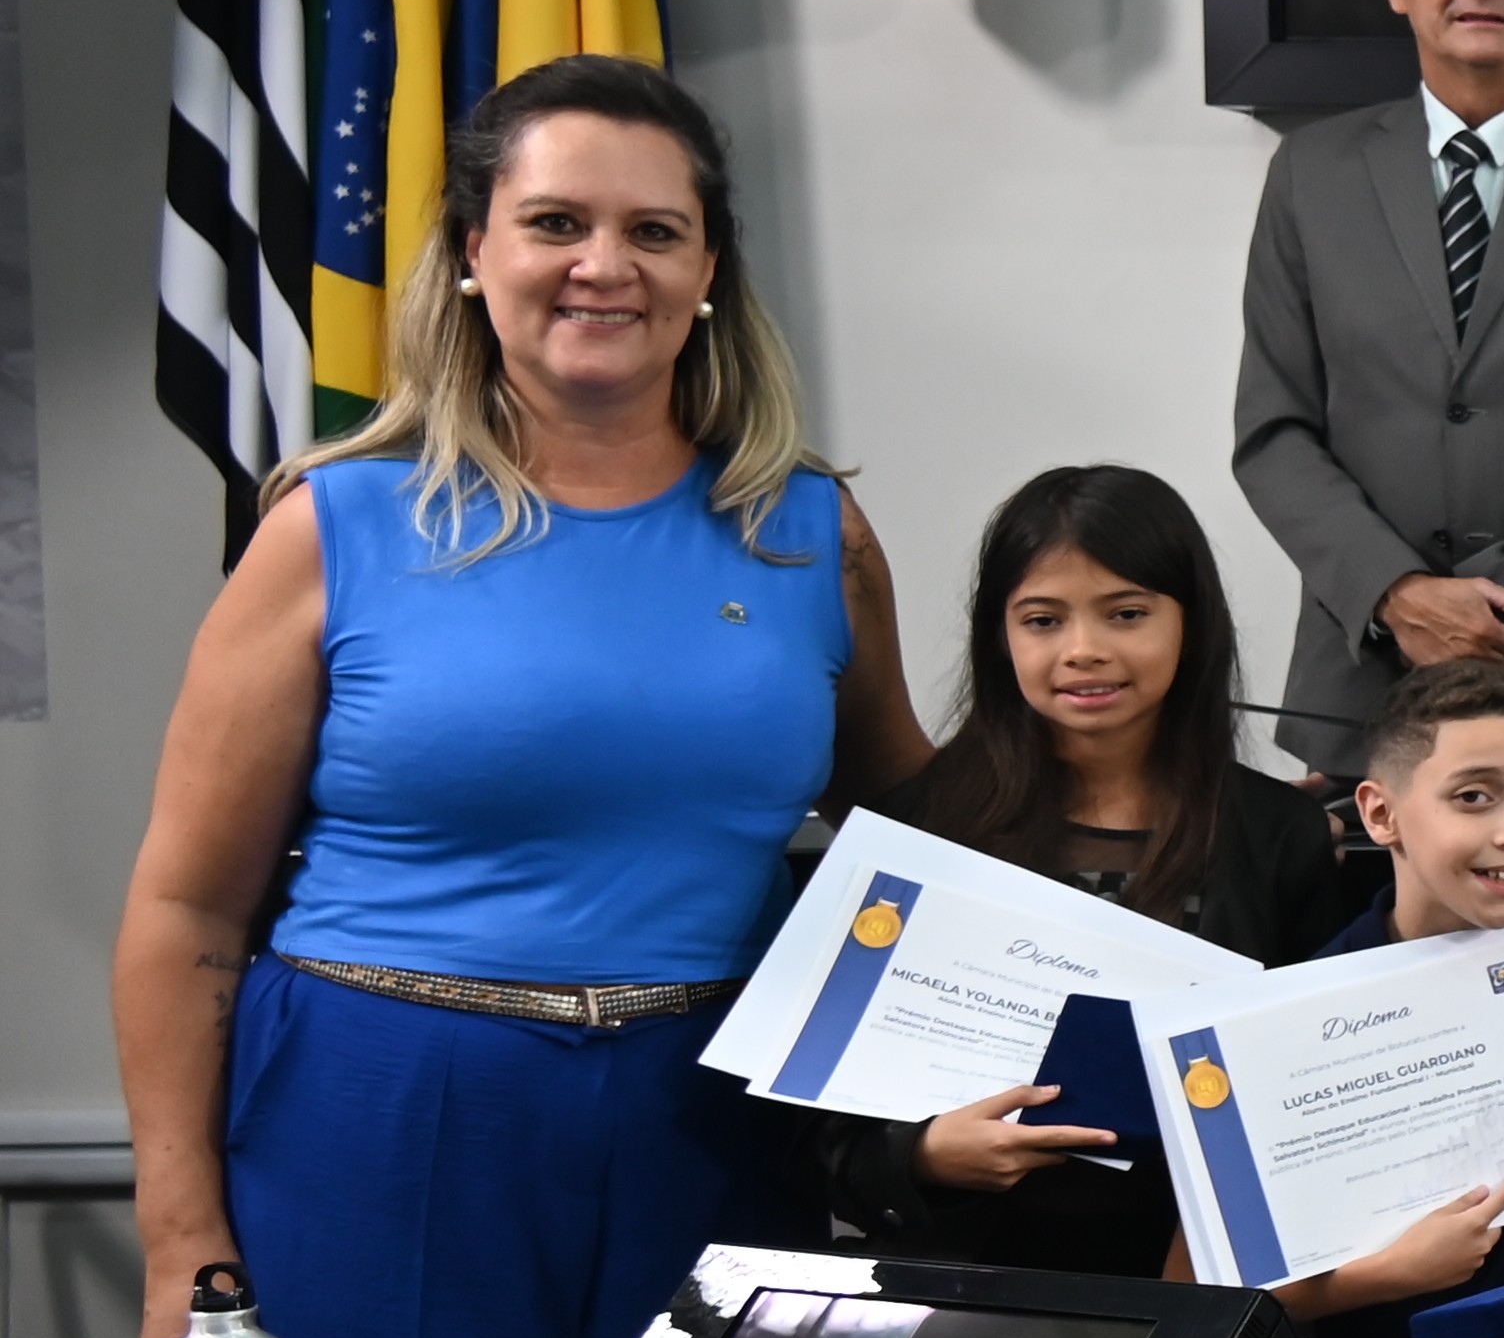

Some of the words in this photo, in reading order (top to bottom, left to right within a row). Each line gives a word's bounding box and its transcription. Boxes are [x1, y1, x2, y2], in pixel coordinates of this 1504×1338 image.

[1006, 938, 1101, 979] Diploma
[890, 967, 962, 995] MICAELA
[963, 988, 1041, 1018] YOLANDA
[1321, 1003, 1413, 1042] Diploma
[1282, 1086, 1333, 1110] LUCAS
[1335, 1069, 1394, 1095] MIGUEL
[1395, 1042, 1487, 1078] GUARDIANO
[1369, 1076, 1424, 1097] Fundamental
[1435, 1061, 1475, 1078] Municipal
